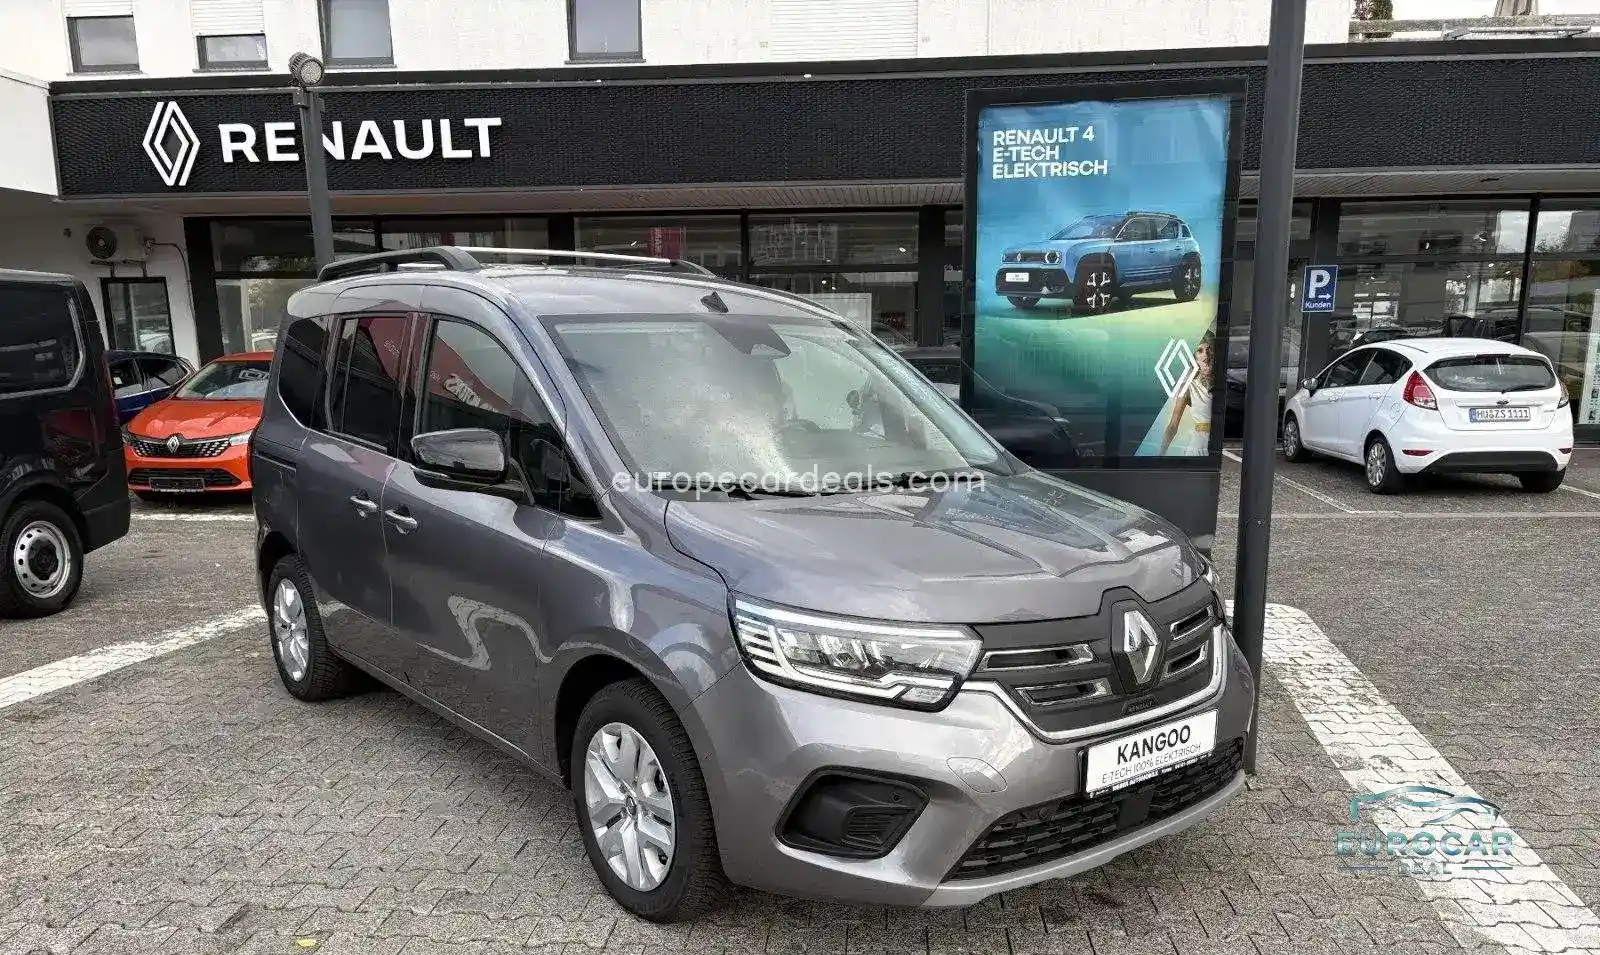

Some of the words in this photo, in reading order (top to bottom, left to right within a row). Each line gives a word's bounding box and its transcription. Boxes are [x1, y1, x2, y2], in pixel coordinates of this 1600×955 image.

[217, 117, 502, 163] RENAULT
[993, 127, 1079, 146] RENAULT
[1082, 125, 1095, 141] 4
[992, 145, 1060, 162] E-TECH
[992, 160, 1108, 179] ELEKTRISCH
[1309, 269, 1331, 299] P
[1305, 301, 1332, 309] Kunden
[1117, 725, 1191, 765] KANGOO
[1102, 764, 1132, 784] E-TECH
[1155, 742, 1202, 766] ELEKTRISCH
